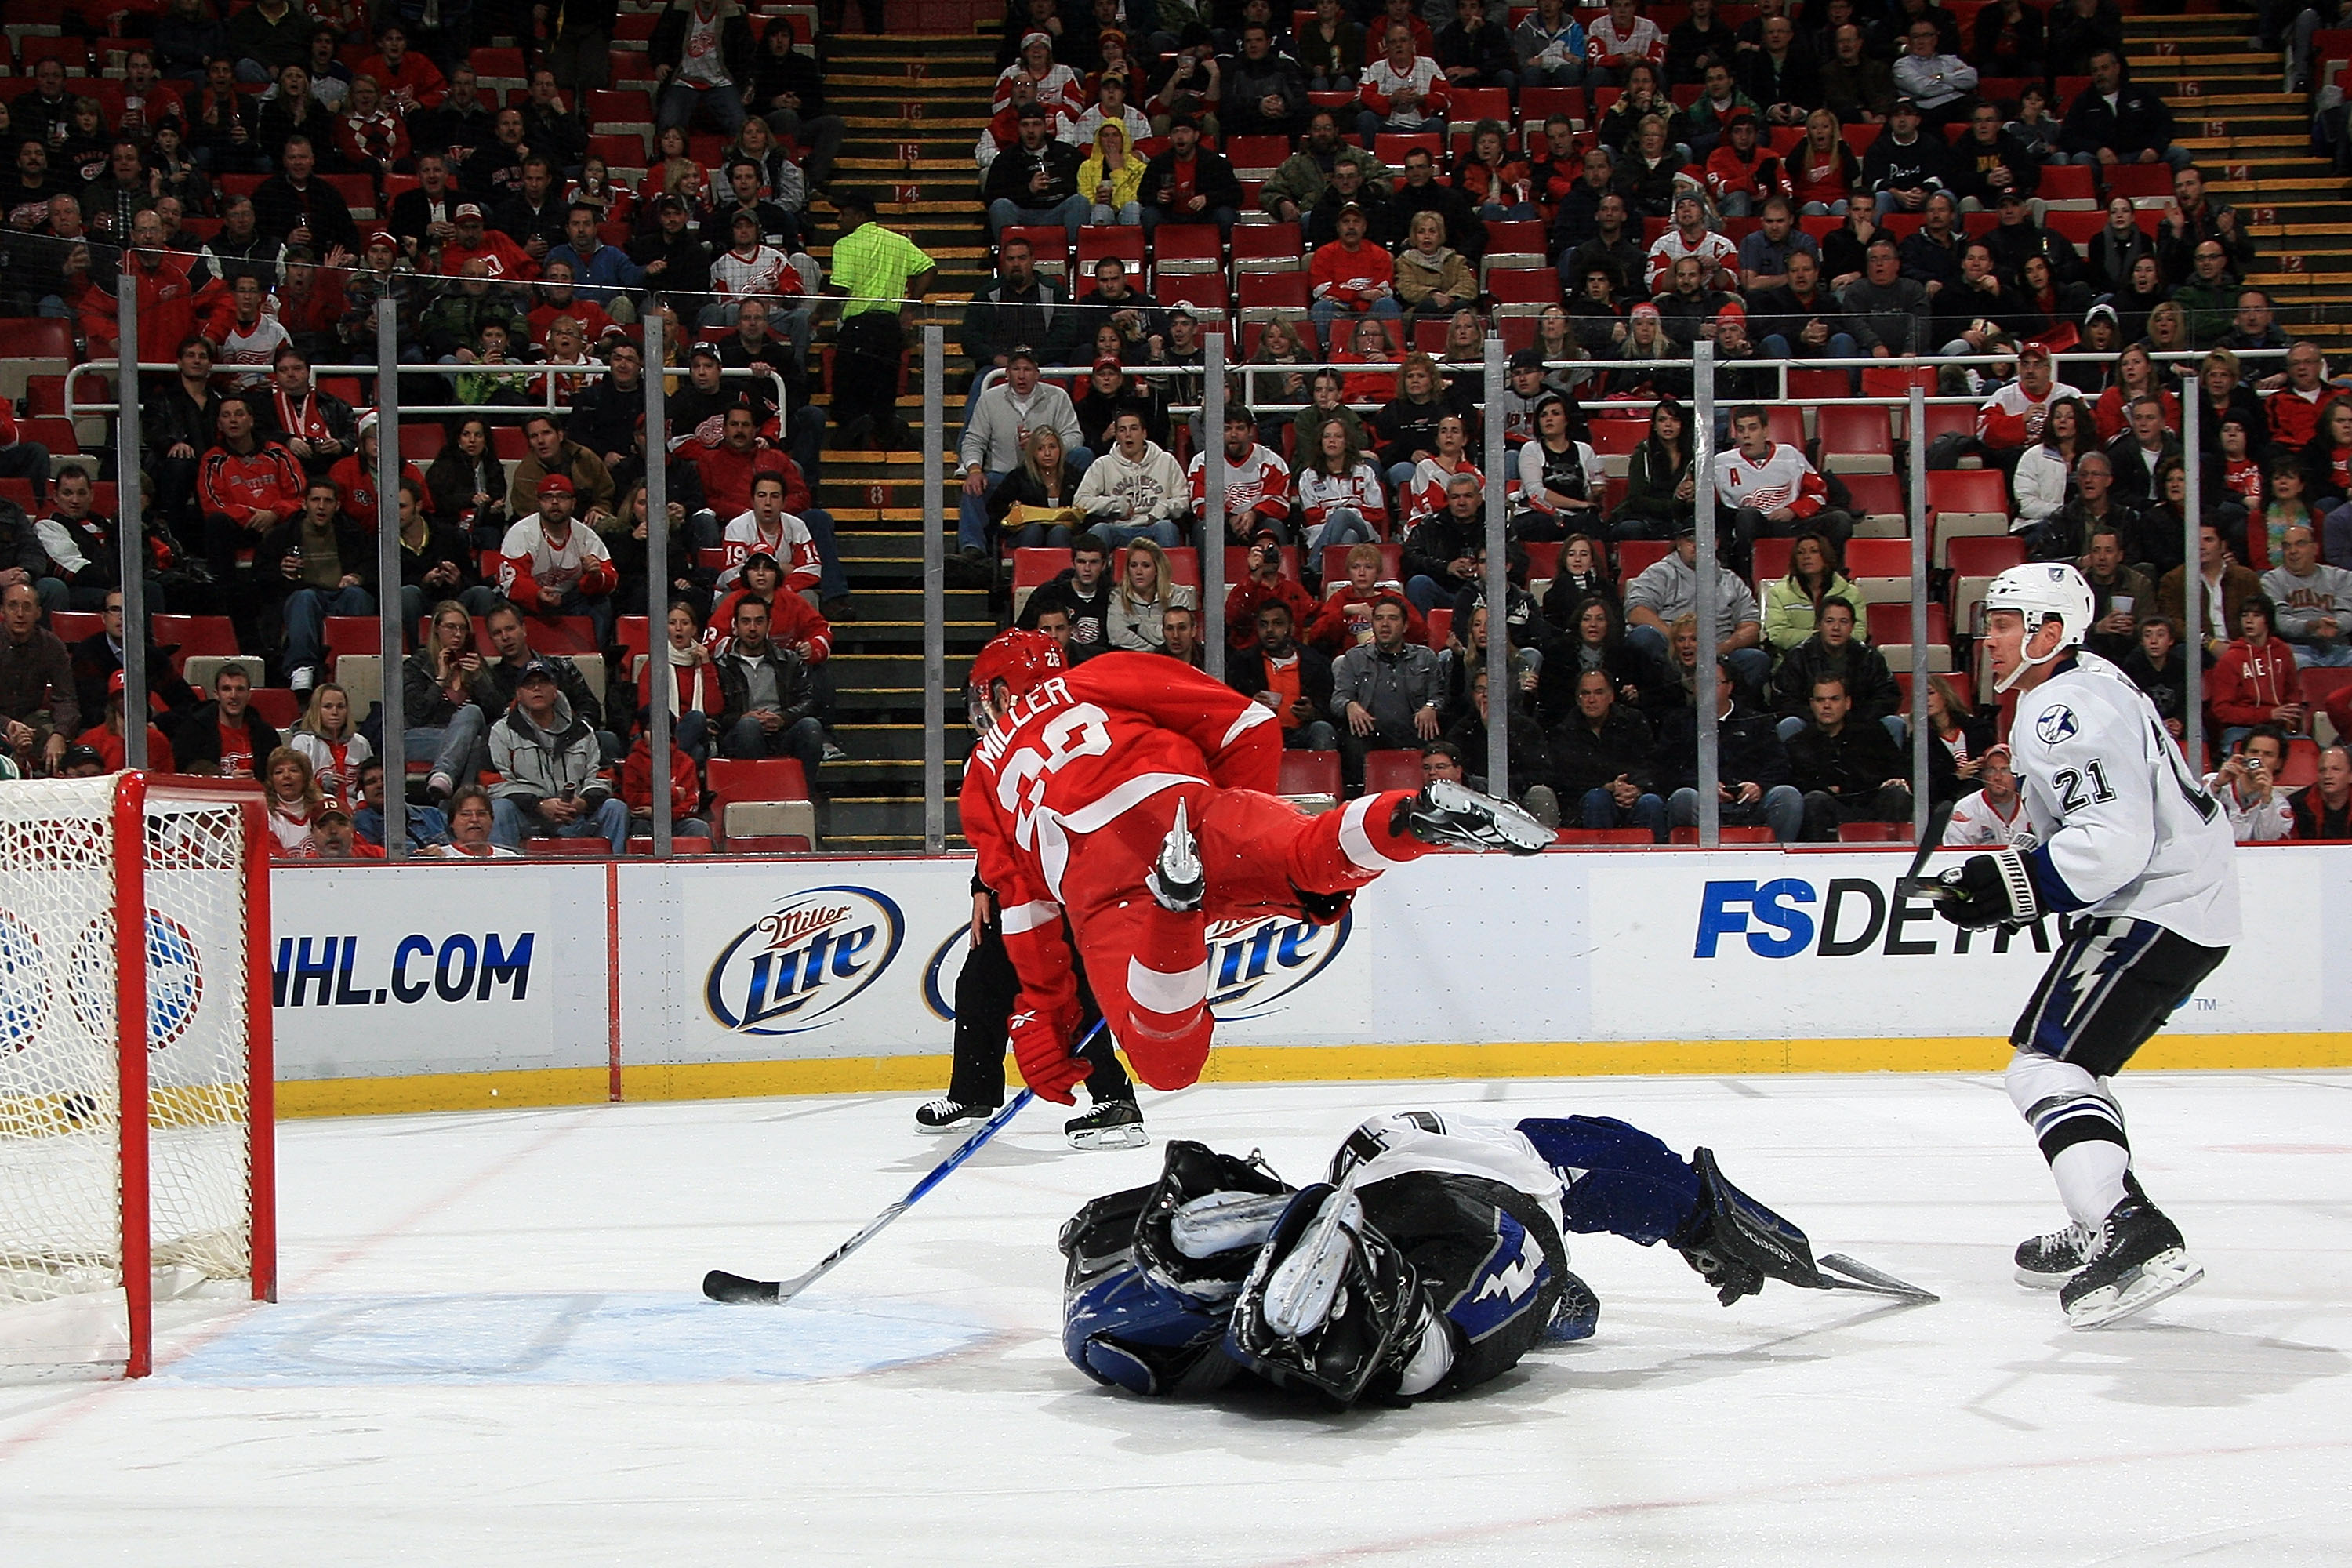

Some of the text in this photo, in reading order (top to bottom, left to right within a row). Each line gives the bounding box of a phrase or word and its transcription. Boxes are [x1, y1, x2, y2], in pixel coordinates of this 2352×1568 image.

[2156, 43, 2176, 56] 17
[906, 64, 927, 78] 17
[2177, 82, 2200, 96] 16
[902, 103, 923, 118] 16
[2201, 122, 2224, 137] 15
[898, 144, 919, 161] 15
[2224, 165, 2248, 180] 14
[895, 185, 920, 202] 14
[2280, 256, 2303, 272] 12
[1352, 476, 1365, 495] C
[1730, 468, 1741, 487] A
[870, 485, 884, 504] 8
[725, 544, 747, 566] 19
[1044, 652, 1061, 667] 26
[976, 677, 1076, 776] MILLER
[2053, 758, 2118, 815] 21
[757, 905, 851, 944] Miller
[737, 924, 876, 1029] Lite
